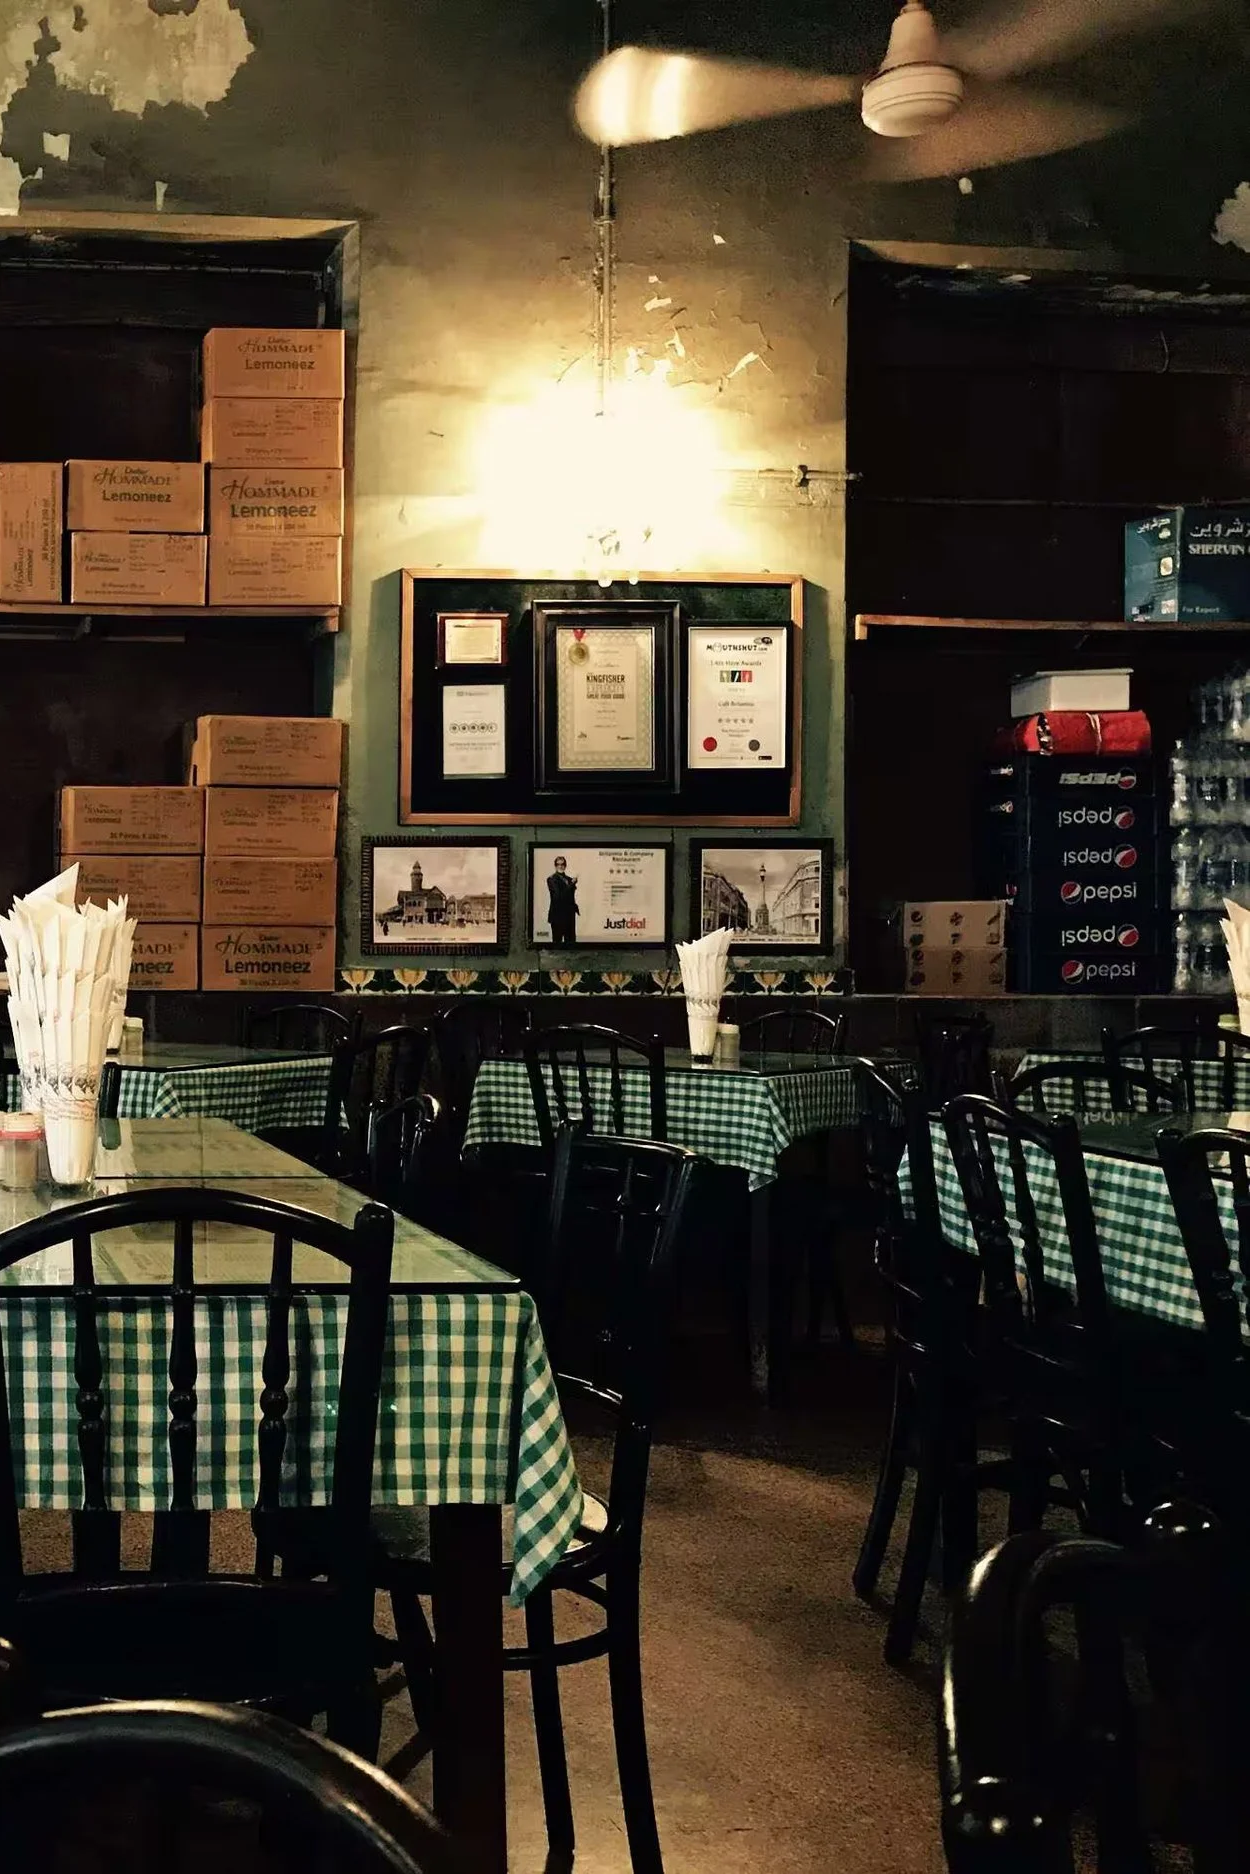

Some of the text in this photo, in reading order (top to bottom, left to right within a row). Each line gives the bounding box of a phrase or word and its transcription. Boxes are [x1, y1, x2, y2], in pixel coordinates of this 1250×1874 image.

[245, 360, 315, 370] Lemoneez
[93, 467, 172, 486] HOMMADE
[221, 475, 320, 499] HOMMADE
[102, 490, 172, 503] Lemoneez
[230, 504, 317, 518] Lemoneez
[1188, 544, 1244, 555] SHERVIN
[1195, 606, 1220, 614] Export
[586, 674, 626, 684] KINGFISHER
[1058, 807, 1112, 828] pepsi
[1063, 848, 1113, 866] pepsi
[1083, 881, 1137, 903] pepsi
[604, 917, 647, 930] Justdial
[215, 932, 314, 955] HOMMADE
[1061, 925, 1116, 947] pepsi
[225, 959, 311, 973] Lemoneez
[1086, 961, 1136, 980] pepsi
